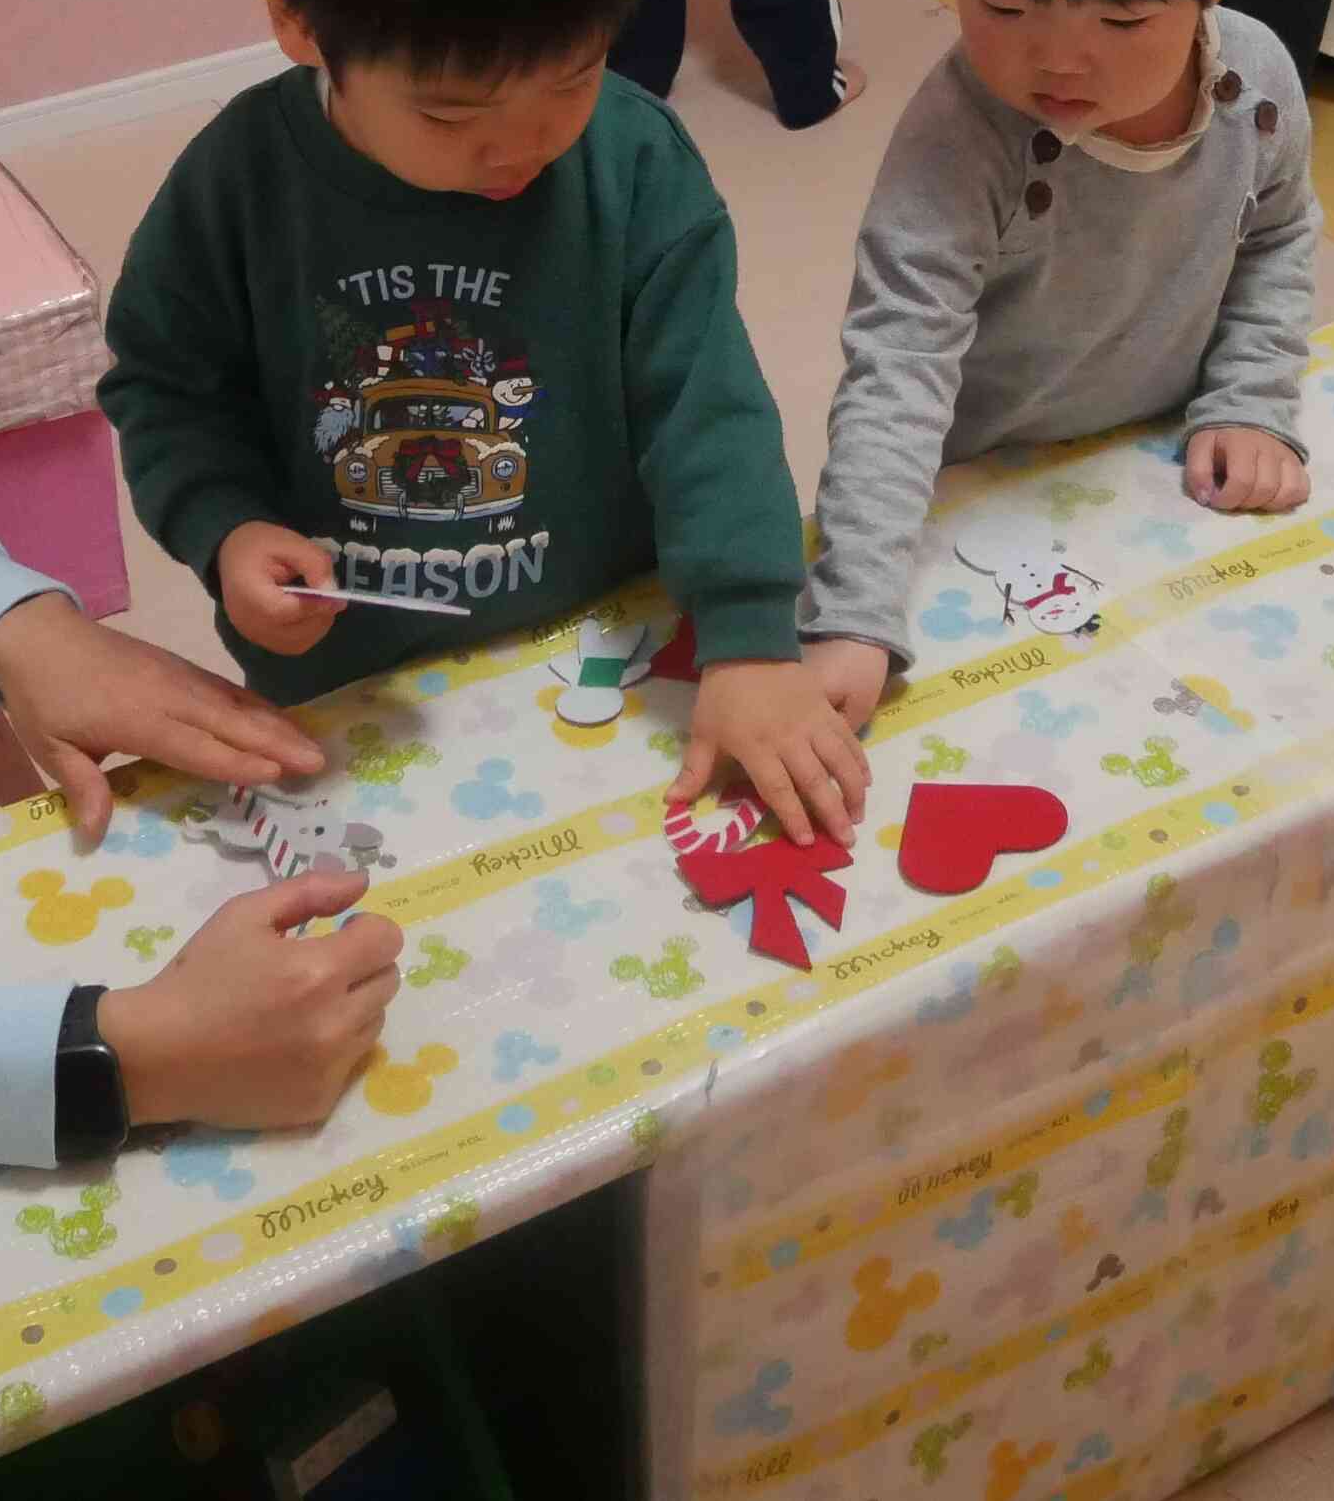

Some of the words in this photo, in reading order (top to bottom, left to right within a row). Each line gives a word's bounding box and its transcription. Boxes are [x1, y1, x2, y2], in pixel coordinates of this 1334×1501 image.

[338, 265, 415, 306] 'TIS
[428, 264, 511, 307] THE
[312, 531, 550, 604] EASON
[1163, 559, 1260, 600] Mickey
[948, 647, 1052, 690] Mickey
[468, 828, 585, 877] Mickey
[827, 929, 945, 980] Mickey
[255, 1173, 389, 1239] Mickey
